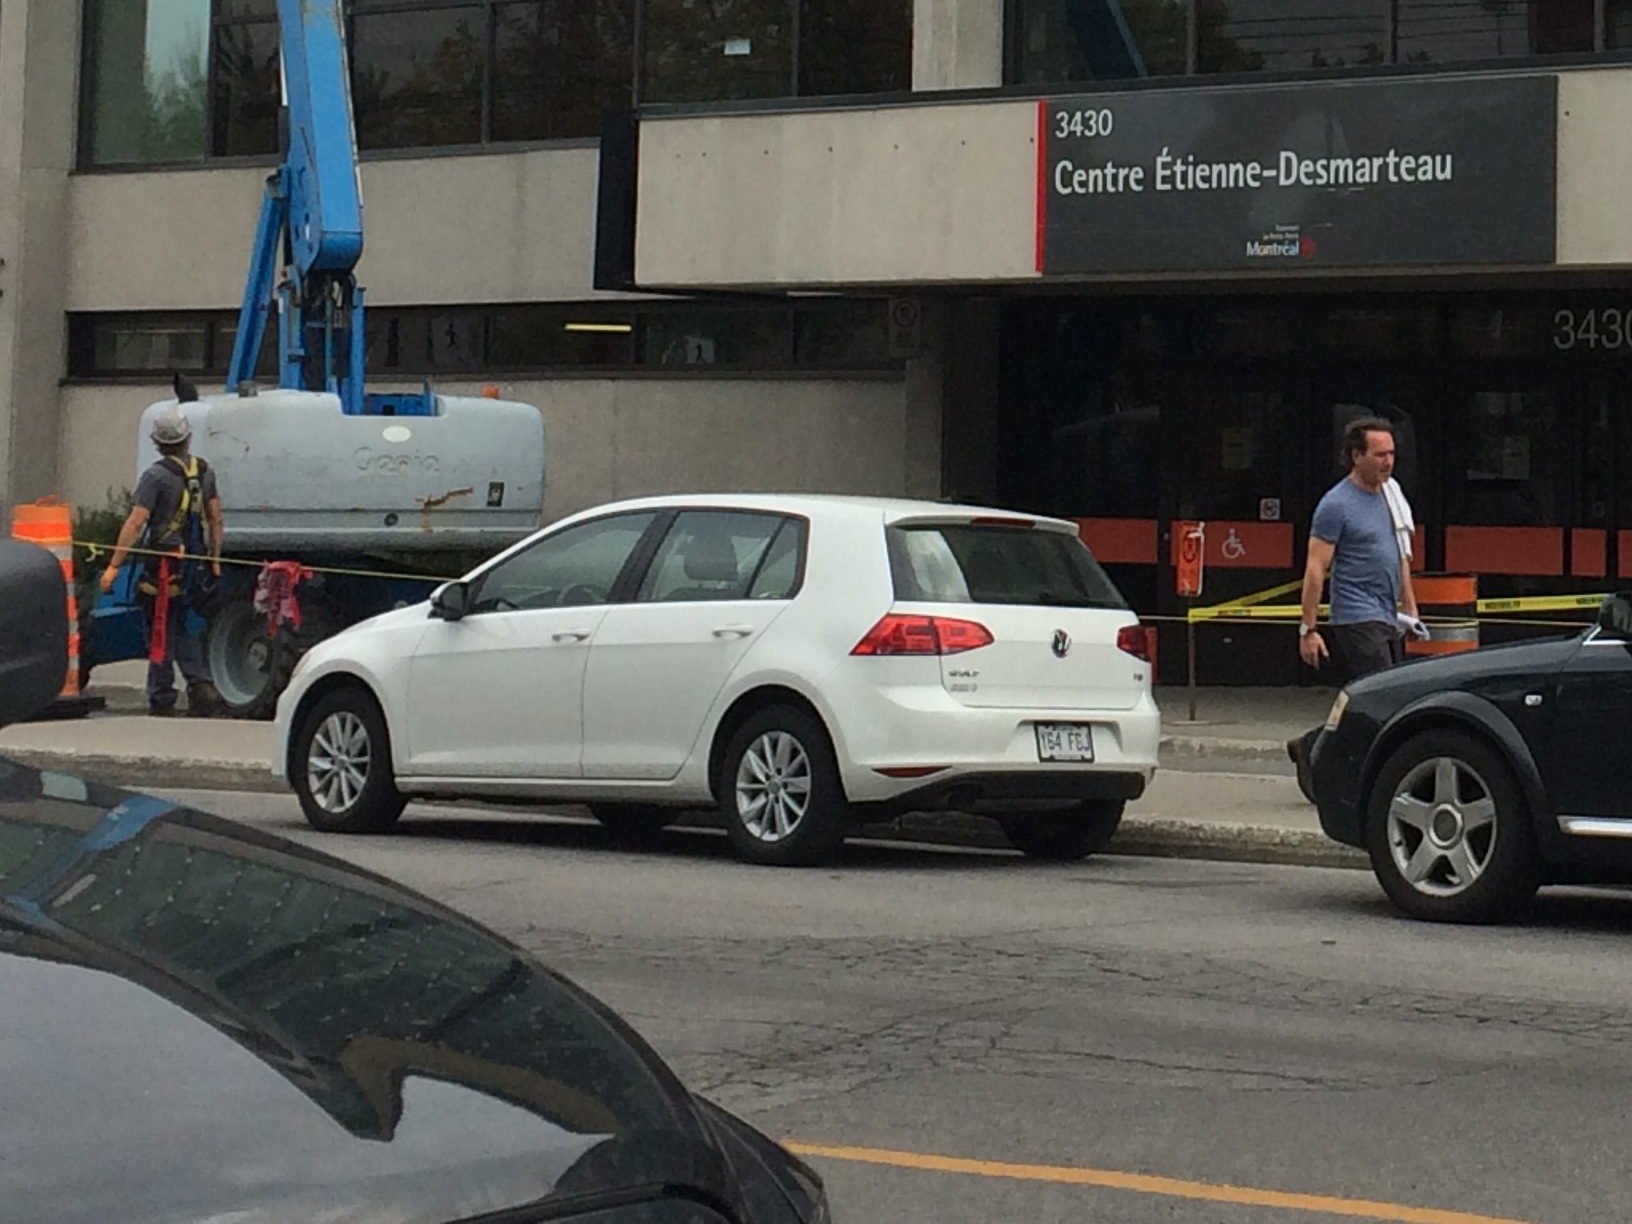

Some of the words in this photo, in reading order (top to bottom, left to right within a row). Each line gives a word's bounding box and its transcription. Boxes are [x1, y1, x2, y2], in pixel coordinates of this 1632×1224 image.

[1055, 109, 1113, 138] 3430
[1054, 159, 1145, 195] Centre
[1155, 146, 1453, 191] Étienne-Desmarteau
[1246, 240, 1300, 257] Montréal
